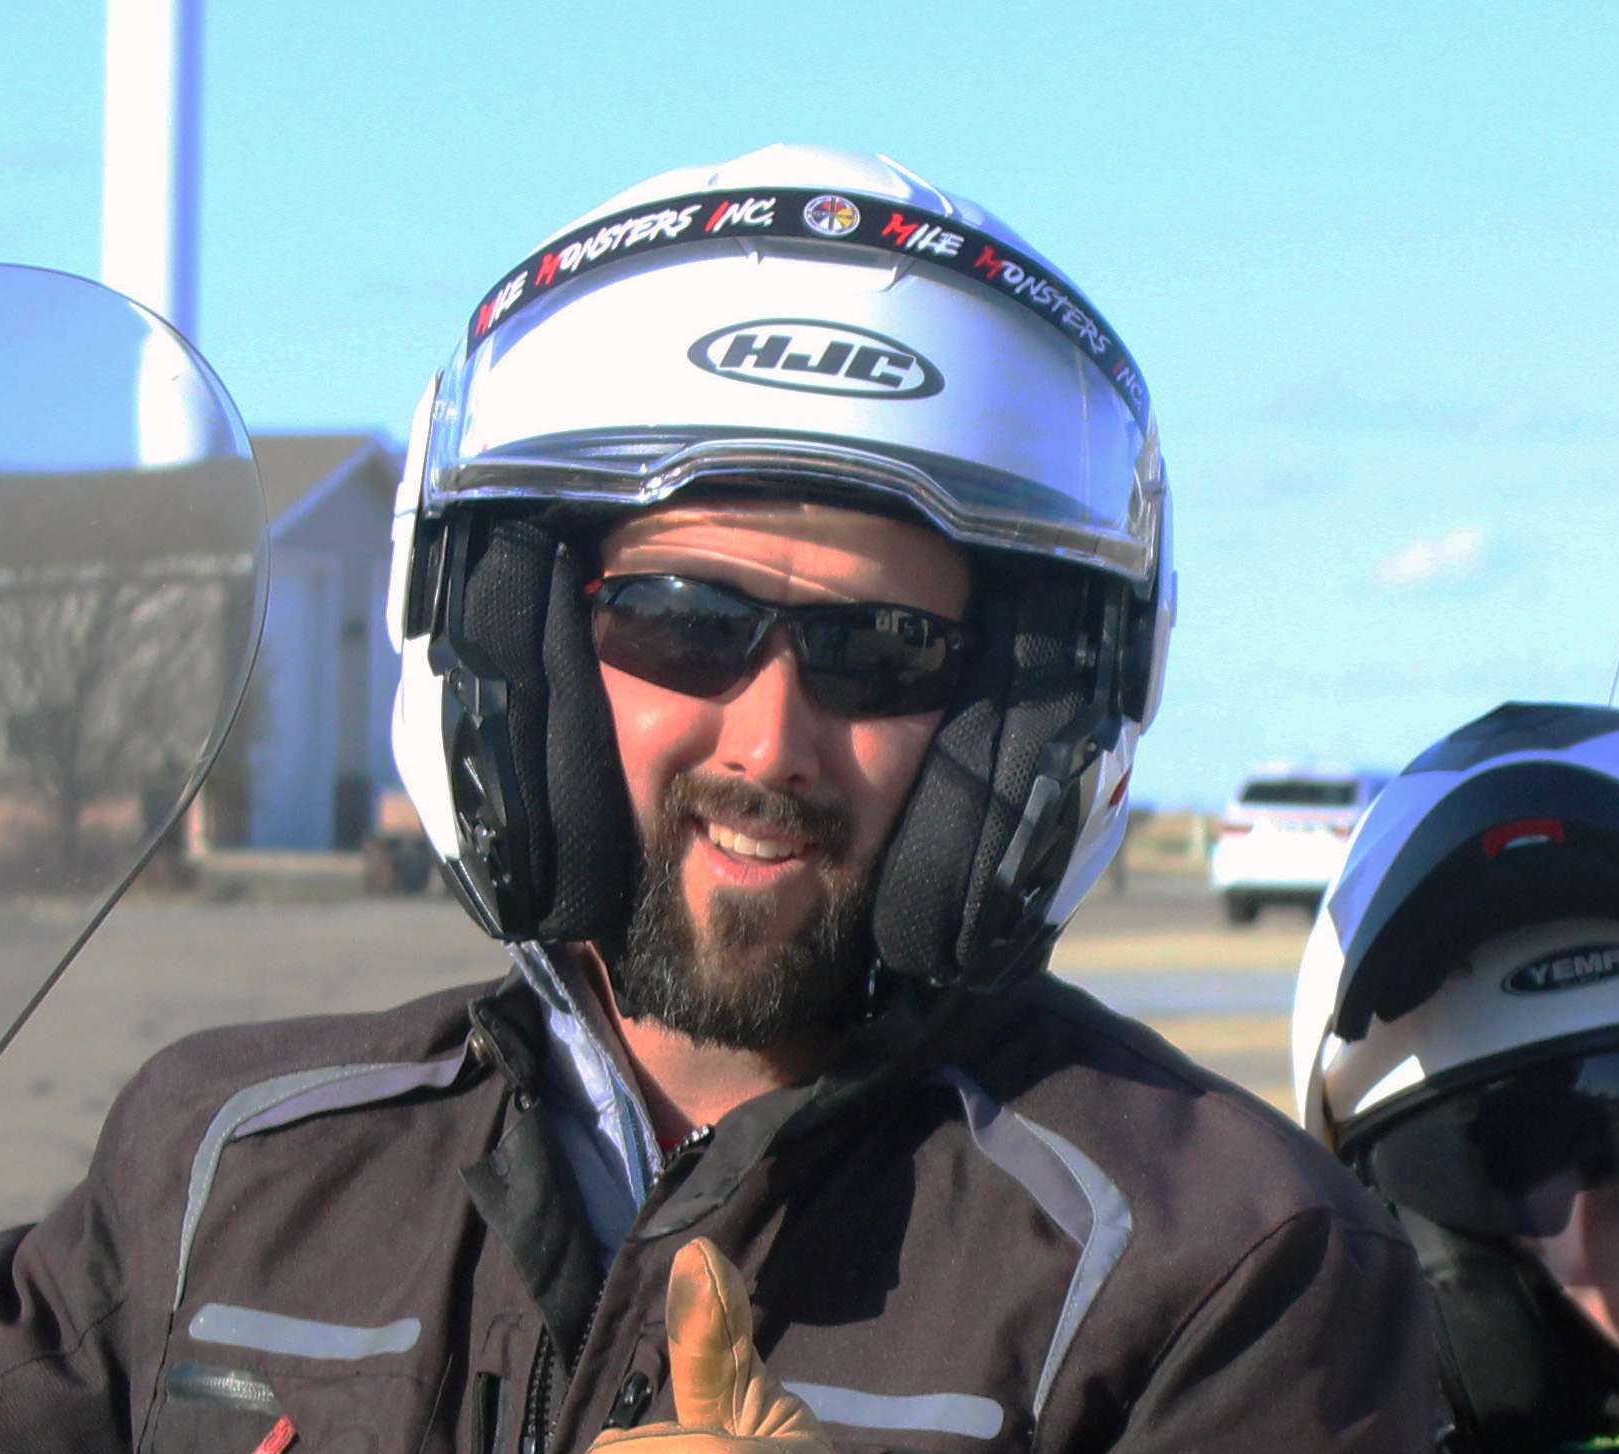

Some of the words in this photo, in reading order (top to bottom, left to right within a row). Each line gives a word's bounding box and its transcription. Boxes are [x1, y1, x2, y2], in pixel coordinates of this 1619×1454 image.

[474, 271, 528, 336] MILE
[535, 204, 701, 286] MONSTERS
[705, 197, 776, 233] INC.
[882, 212, 965, 257] MILE
[973, 244, 1112, 354] MONSTERS
[719, 333, 916, 389] HJC
